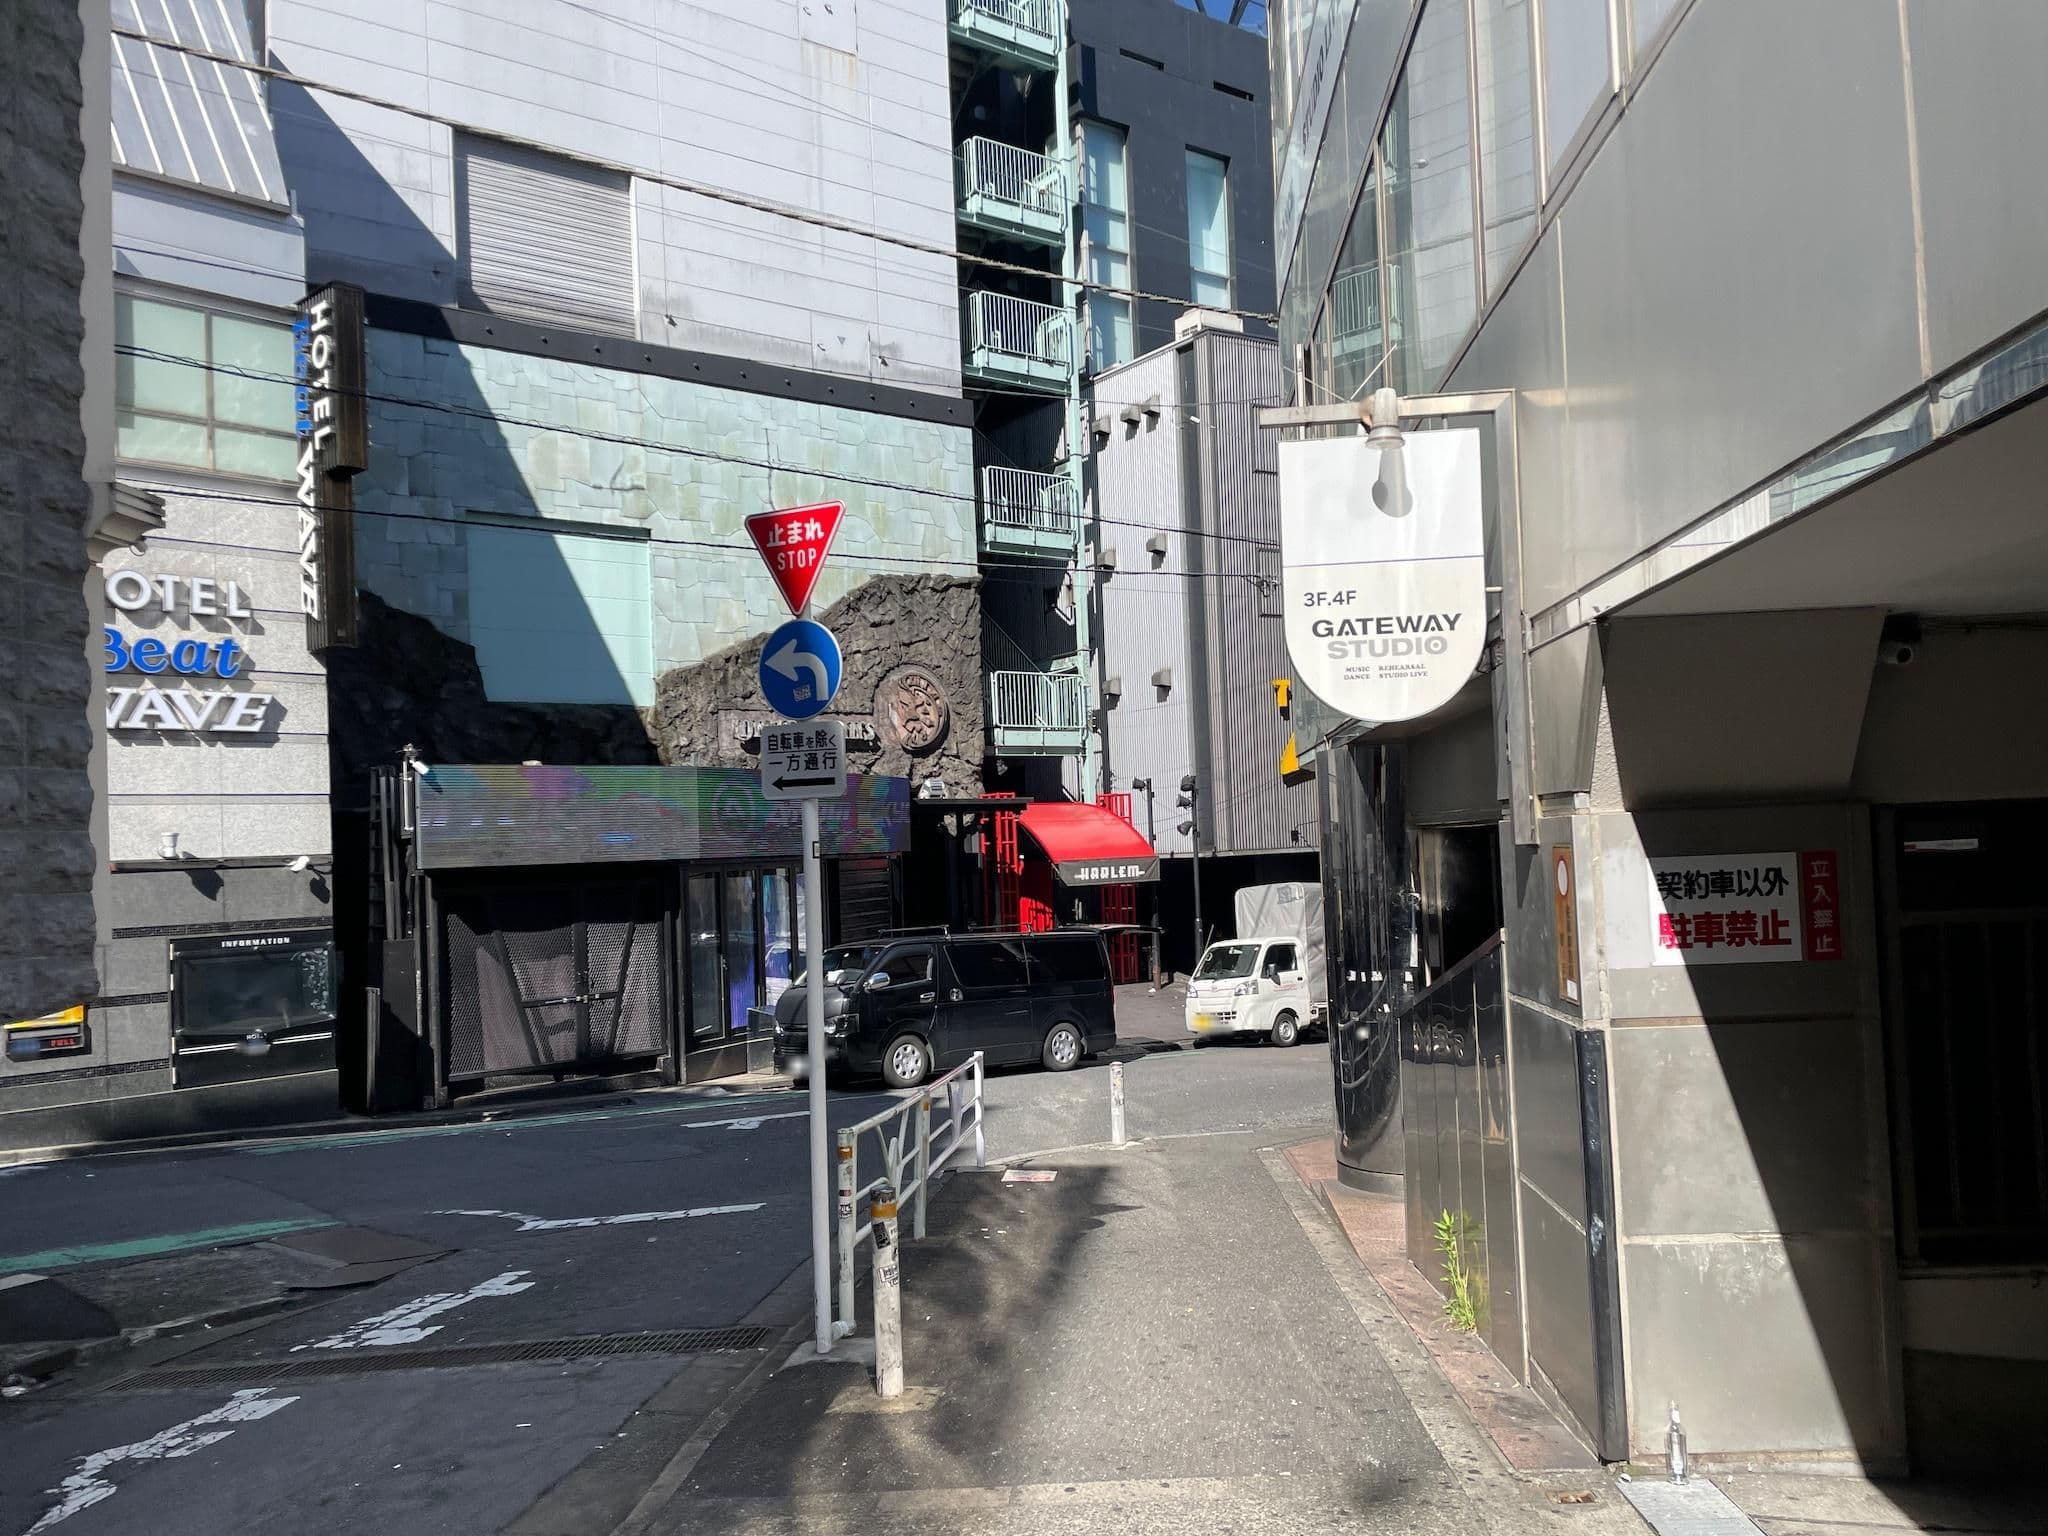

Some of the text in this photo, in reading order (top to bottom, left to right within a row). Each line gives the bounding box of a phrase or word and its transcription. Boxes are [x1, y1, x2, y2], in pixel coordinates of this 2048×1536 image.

[310, 300, 332, 451] HOTEL
[296, 440, 320, 621] WAVE
[766, 517, 825, 547] 止まれ
[777, 548, 817, 571] STOP
[105, 570, 251, 618] OTEL
[1303, 590, 1357, 608] 3F.4F
[1312, 613, 1462, 638] GATEWAY
[104, 626, 241, 678] Beat
[1327, 635, 1448, 660] STUDIO
[1344, 670, 1428, 681] DANCE STUDIO LIVE
[1345, 663, 1426, 673] MUSIC REHEARSAL
[767, 730, 837, 751] 自転車を除く
[768, 752, 838, 772] 一方通行
[1075, 865, 1145, 880] HARLEM
[1656, 867, 1789, 900] 契約車以外
[1810, 859, 1836, 954] 立入禁止
[1658, 908, 1792, 950] 駐車禁止
[221, 937, 290, 948] INFORMATION
